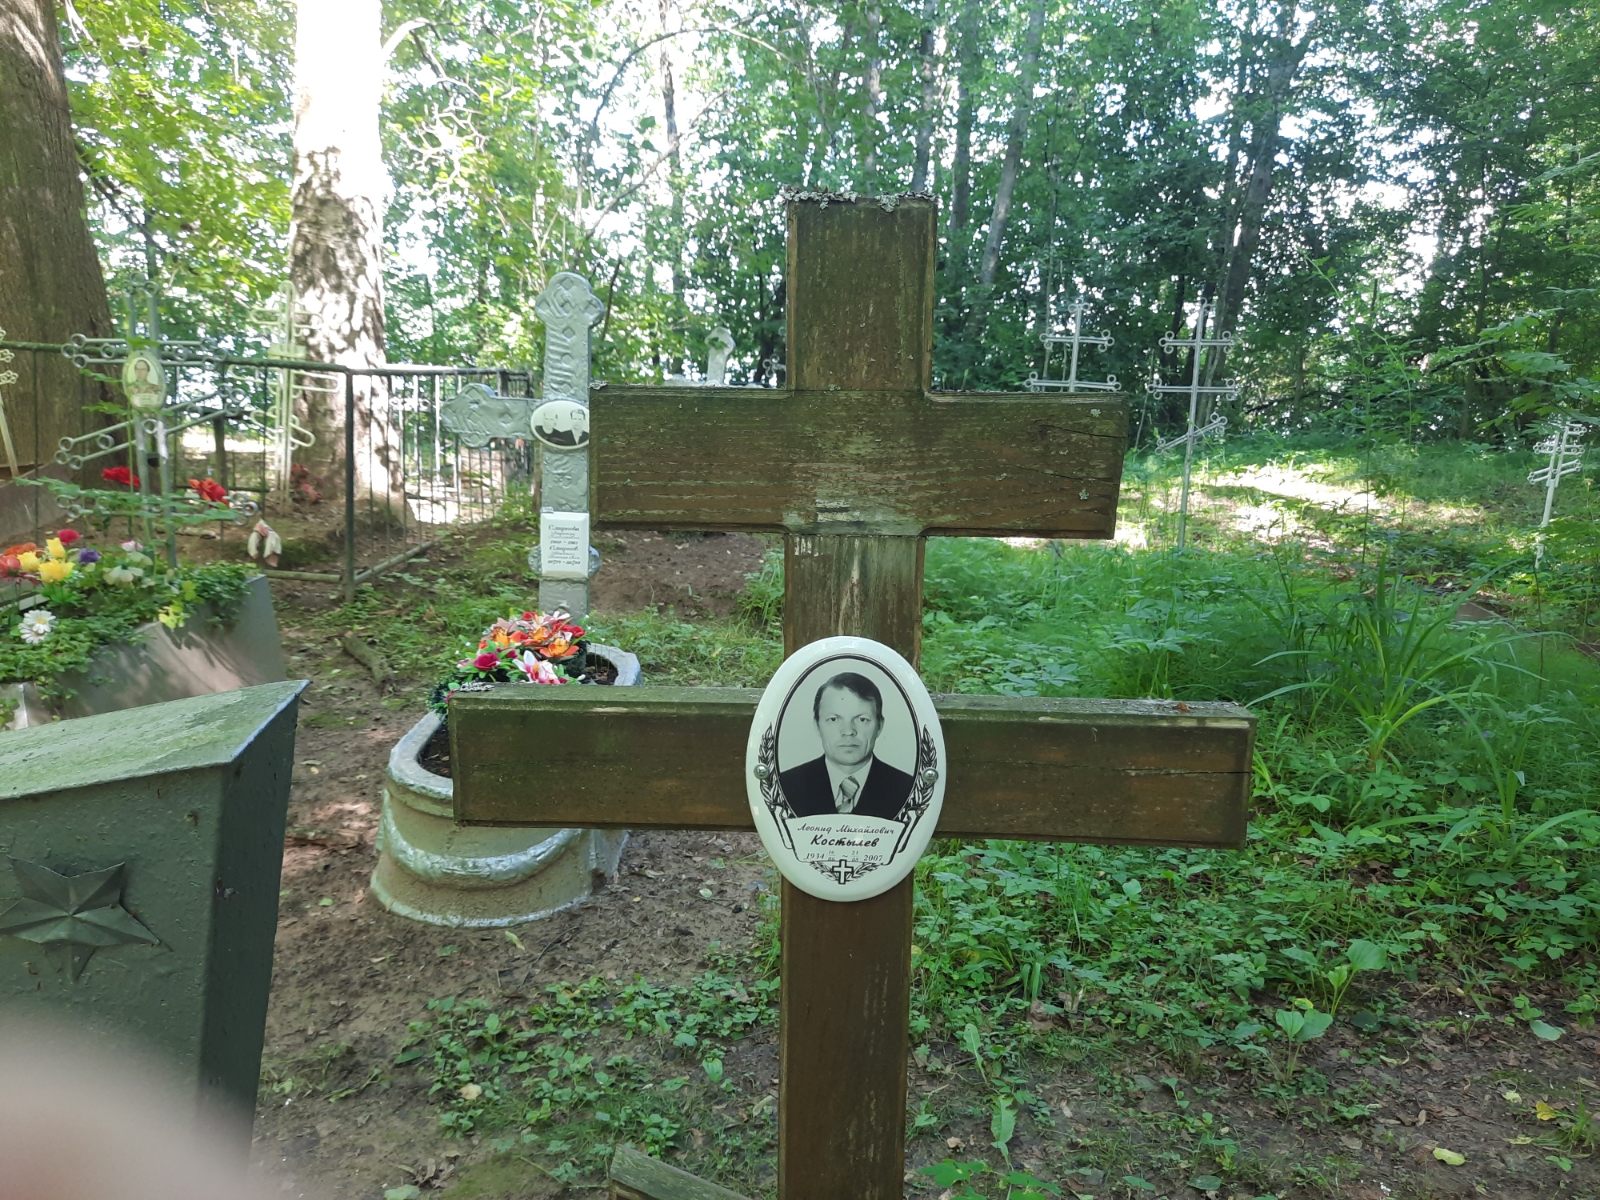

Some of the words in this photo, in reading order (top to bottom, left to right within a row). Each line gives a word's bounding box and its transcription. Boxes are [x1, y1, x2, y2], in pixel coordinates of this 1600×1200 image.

[797, 823, 832, 834] Леонид
[836, 824, 895, 835] Михайлович
[810, 834, 880, 847] Костылев
